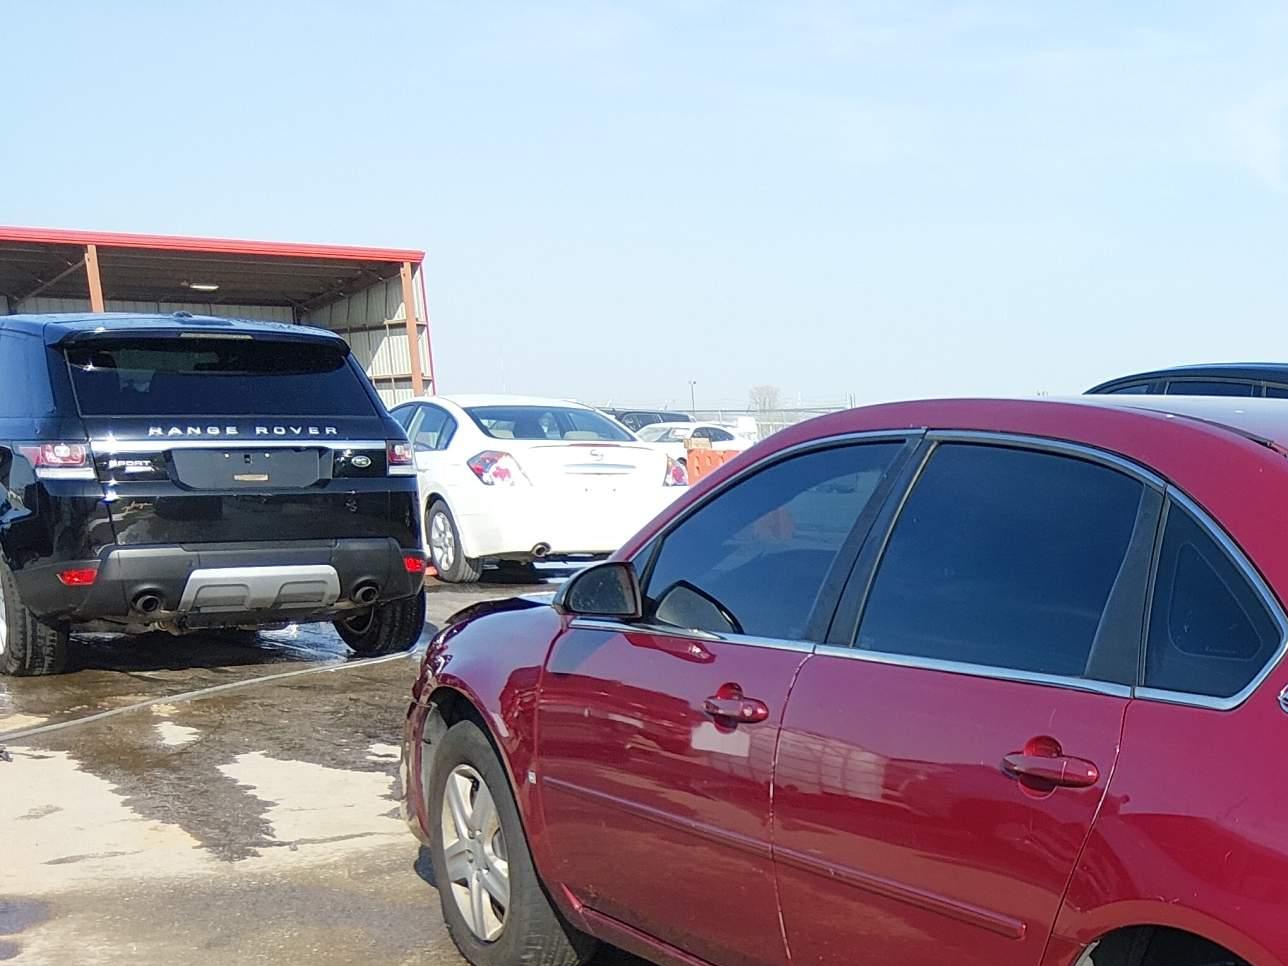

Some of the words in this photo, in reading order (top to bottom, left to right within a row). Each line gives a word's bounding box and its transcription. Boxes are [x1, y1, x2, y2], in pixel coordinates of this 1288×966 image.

[149, 426, 239, 437] RANGE
[256, 426, 339, 436] ROVER
[109, 459, 152, 468] SPORT
